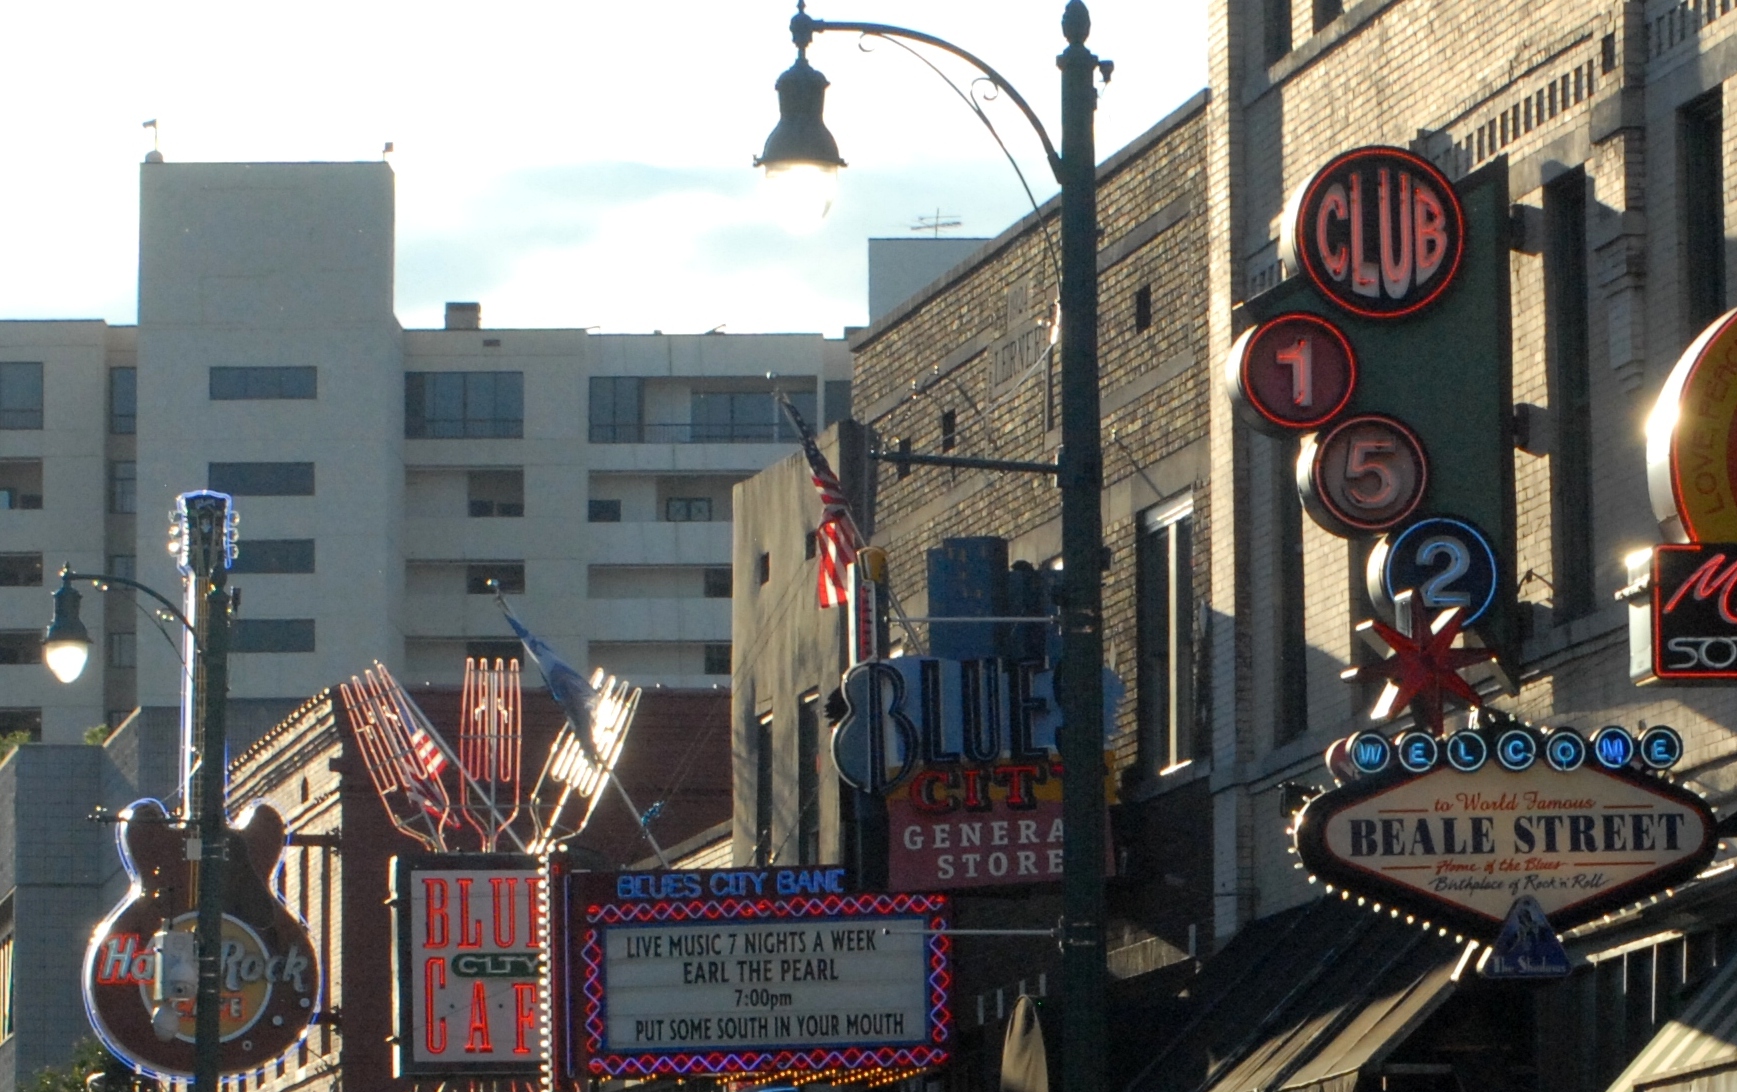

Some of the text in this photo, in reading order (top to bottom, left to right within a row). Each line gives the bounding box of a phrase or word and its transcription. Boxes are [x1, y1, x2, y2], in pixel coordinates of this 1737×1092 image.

[1316, 167, 1449, 299] CLUB
[866, 656, 1062, 794] BLUE
[1352, 731, 1680, 770] WELCOME
[908, 764, 1064, 814] CIT
[1433, 790, 1598, 814] to World Famous
[903, 818, 1064, 850] GENERA
[1348, 812, 1685, 858] BEALE STREET
[937, 849, 1064, 880] STORE
[1434, 856, 1566, 876] Home of the Blues
[617, 872, 701, 899] BLUES
[709, 870, 768, 897] CITY
[1428, 873, 1504, 897] Birthplace
[1508, 875, 1520, 896] of
[1571, 872, 1608, 890] Roll
[626, 929, 877, 958] LIVE MUSIC 7 NIGHTS A WEEK
[457, 955, 541, 974] CITY
[683, 958, 840, 984] EARL THE PEARL
[424, 956, 537, 1055] CAF
[733, 988, 793, 1010] 7:00pm
[635, 1012, 905, 1042] PUT SOME SOUTH IN YOUR MOUTH
